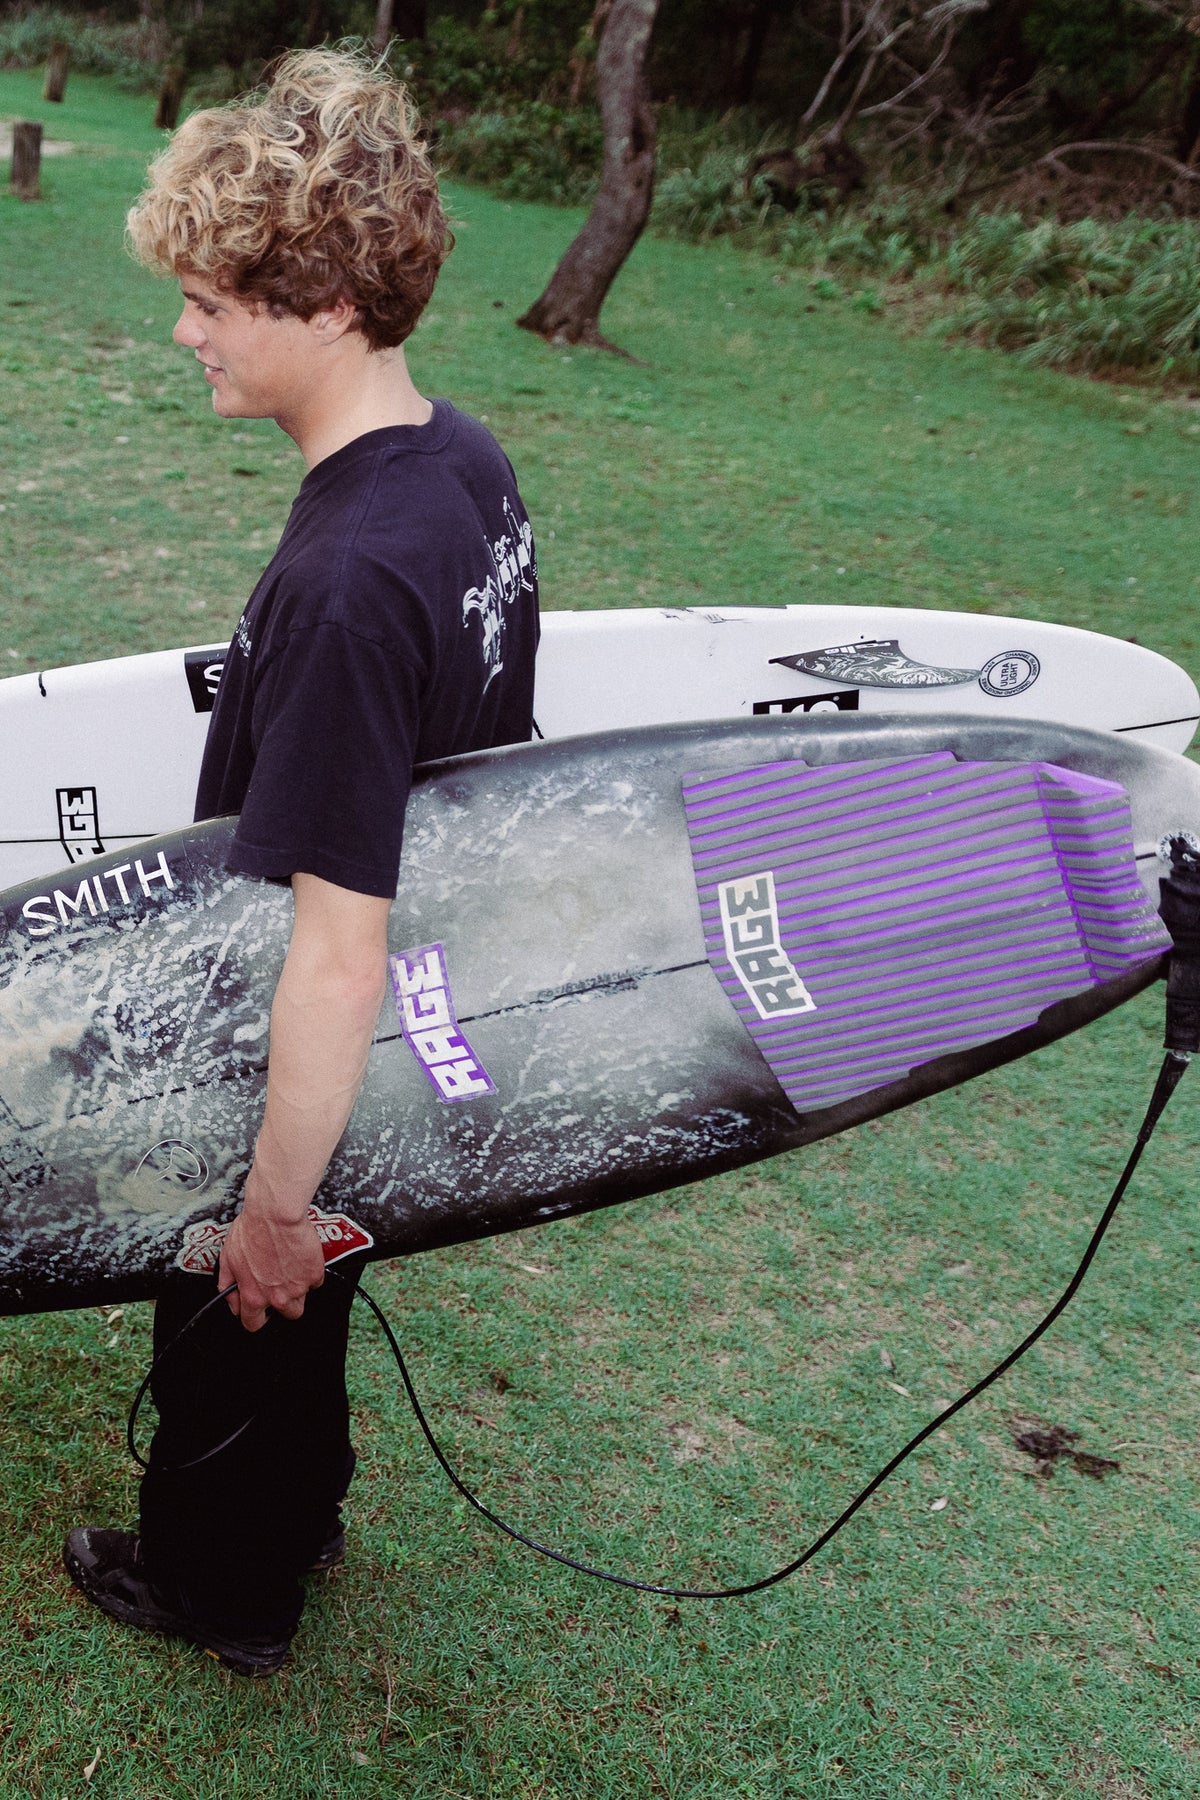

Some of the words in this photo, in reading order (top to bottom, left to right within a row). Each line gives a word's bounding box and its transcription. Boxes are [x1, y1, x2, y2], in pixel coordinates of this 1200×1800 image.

[1000, 662, 1010, 687] ULTRA
[1009, 663, 1019, 685] LIGHT
[21, 851, 175, 935] SMITH
[722, 874, 813, 1016] RAGE
[394, 949, 491, 1099] RAGE
